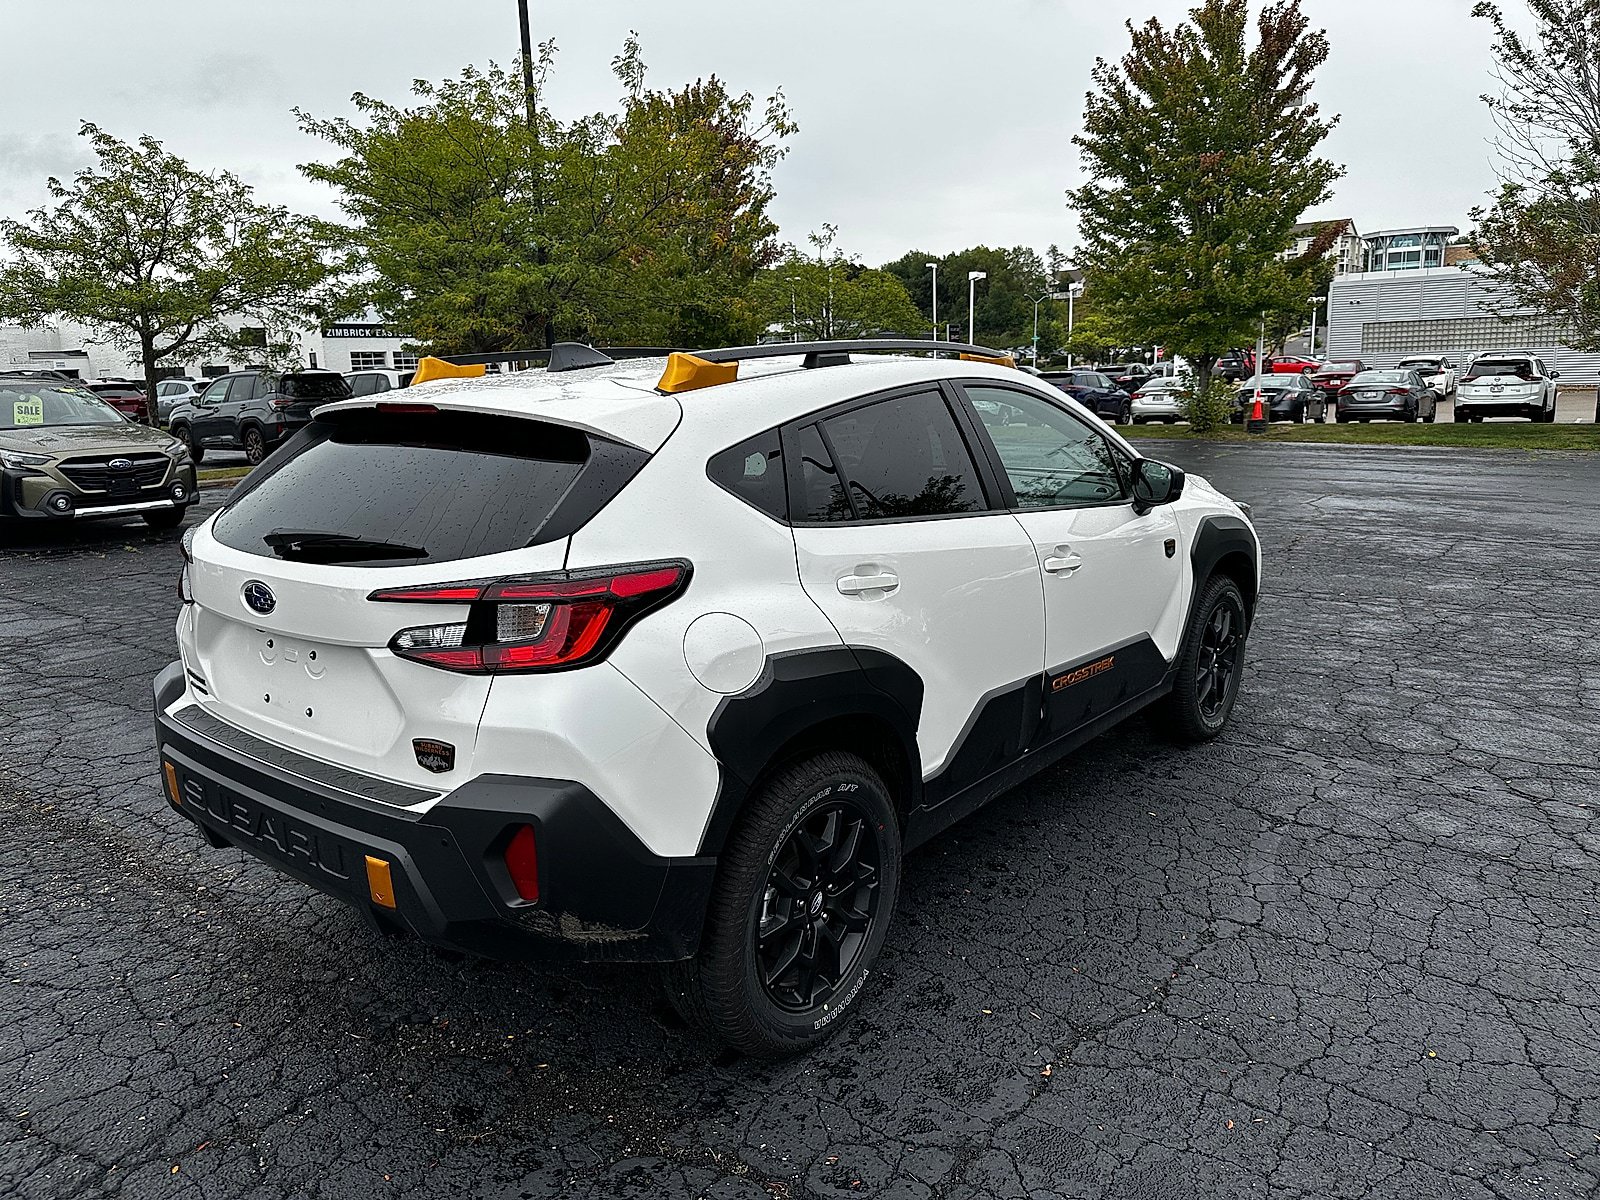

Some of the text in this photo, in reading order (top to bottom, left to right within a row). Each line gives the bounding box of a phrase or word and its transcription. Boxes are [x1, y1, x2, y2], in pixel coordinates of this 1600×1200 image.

[326, 328, 372, 337] ZIMBRICK
[16, 405, 40, 416] SALE
[1052, 655, 1115, 690] CROSSTREK
[414, 745, 450, 756] WILDERNESS
[420, 742, 443, 751] SUBARU
[837, 783, 859, 792] A/T
[183, 778, 351, 880] SUBARU
[813, 968, 870, 1030] YOKOHAMA
